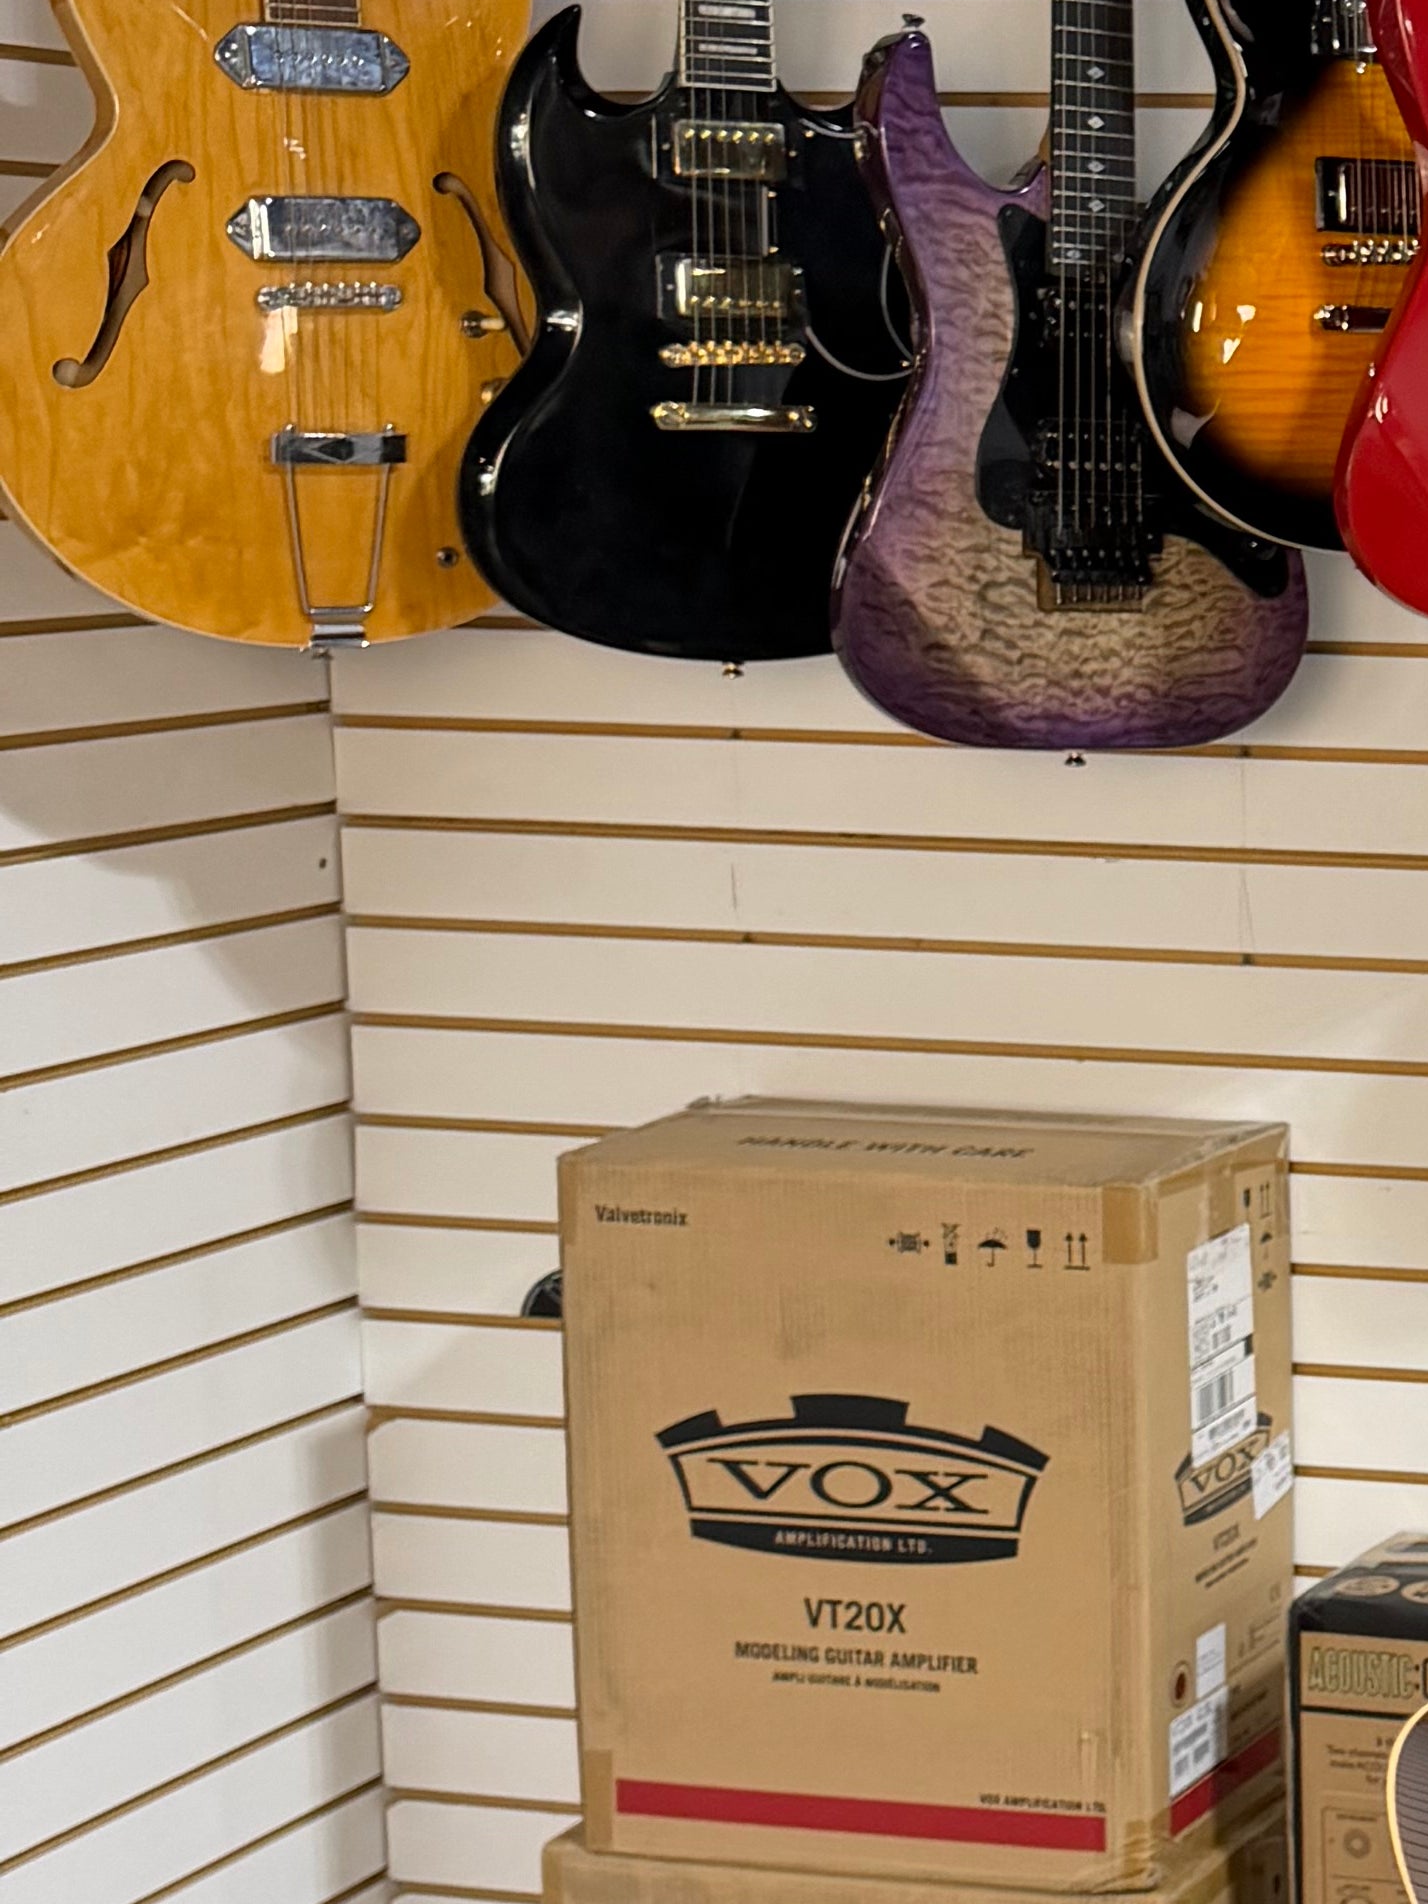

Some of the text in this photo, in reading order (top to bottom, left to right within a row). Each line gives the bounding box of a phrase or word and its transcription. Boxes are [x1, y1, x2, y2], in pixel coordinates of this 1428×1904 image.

[594, 1203, 690, 1227] Valvetronix
[707, 1458, 990, 1516] VOX
[774, 1529, 893, 1553] AMPLIFICATION
[803, 1596, 907, 1635] VT20X
[735, 1641, 978, 1675] MODELING GUITAR AMPLIFIER
